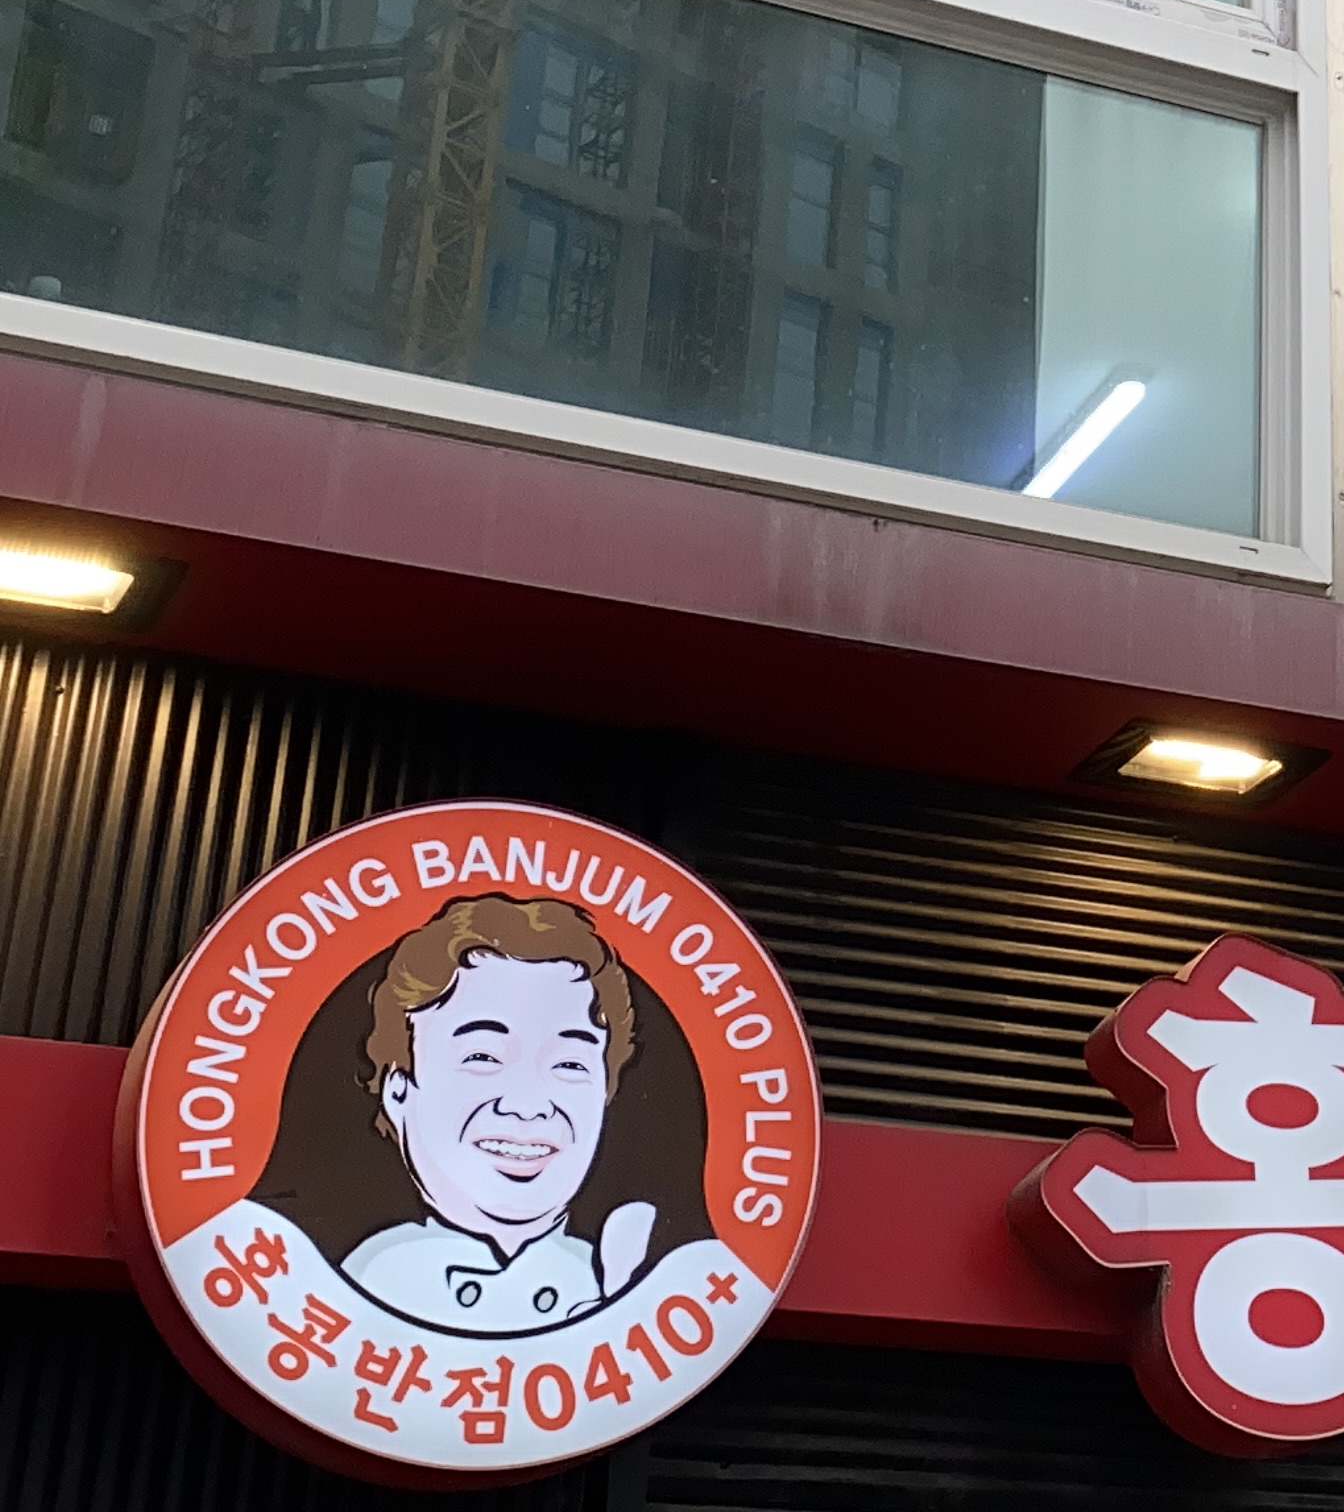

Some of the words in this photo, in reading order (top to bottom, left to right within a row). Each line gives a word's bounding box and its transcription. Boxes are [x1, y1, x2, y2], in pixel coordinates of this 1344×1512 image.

[178, 857, 402, 1182] HONGKONG
[412, 835, 674, 934] BANJUM
[668, 923, 773, 1052] 0410
[732, 1066, 794, 1230] PLUS
